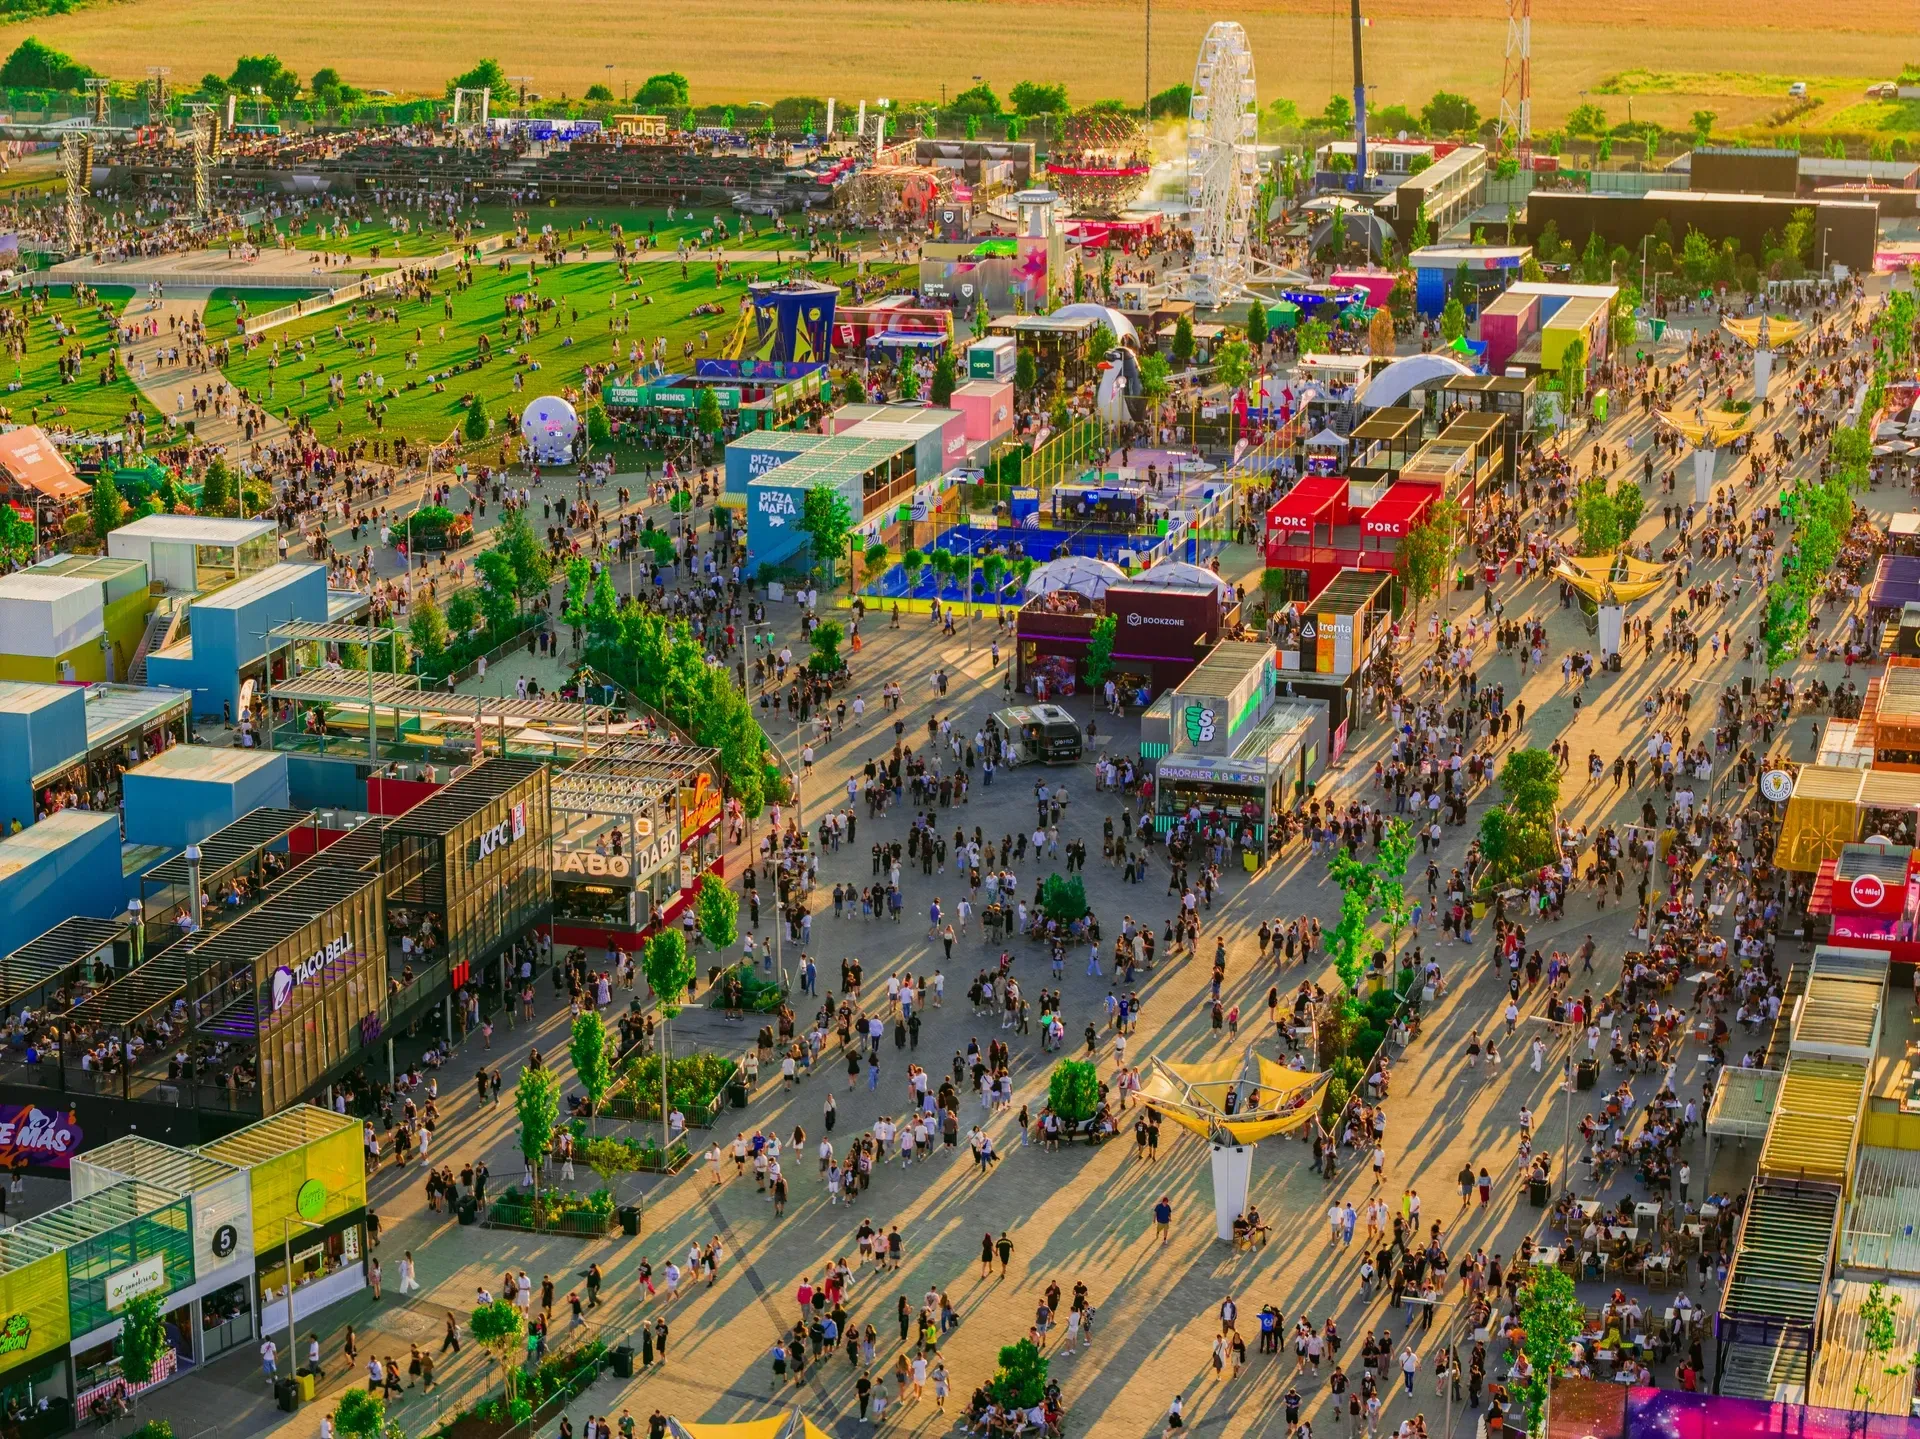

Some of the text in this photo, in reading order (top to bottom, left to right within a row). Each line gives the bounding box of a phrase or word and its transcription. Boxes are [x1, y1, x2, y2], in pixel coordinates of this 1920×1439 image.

[621, 119, 666, 136] nuba
[656, 393, 685, 401] DRINKS
[750, 454, 781, 466] PIZZA
[749, 463, 774, 475] MAF
[760, 491, 793, 504] PIZZA
[758, 501, 796, 514] MAFIA
[1275, 516, 1307, 526] PORC
[1367, 522, 1400, 533] PORC
[1143, 616, 1185, 626] BOOKZONE
[1319, 622, 1351, 633] trenta
[479, 819, 509, 860] KFC
[641, 829, 678, 874] DABO
[546, 849, 629, 878] DABO
[1854, 887, 1881, 896] La Mici
[294, 931, 353, 986] TACO BELL
[220, 1228, 231, 1250] 5
